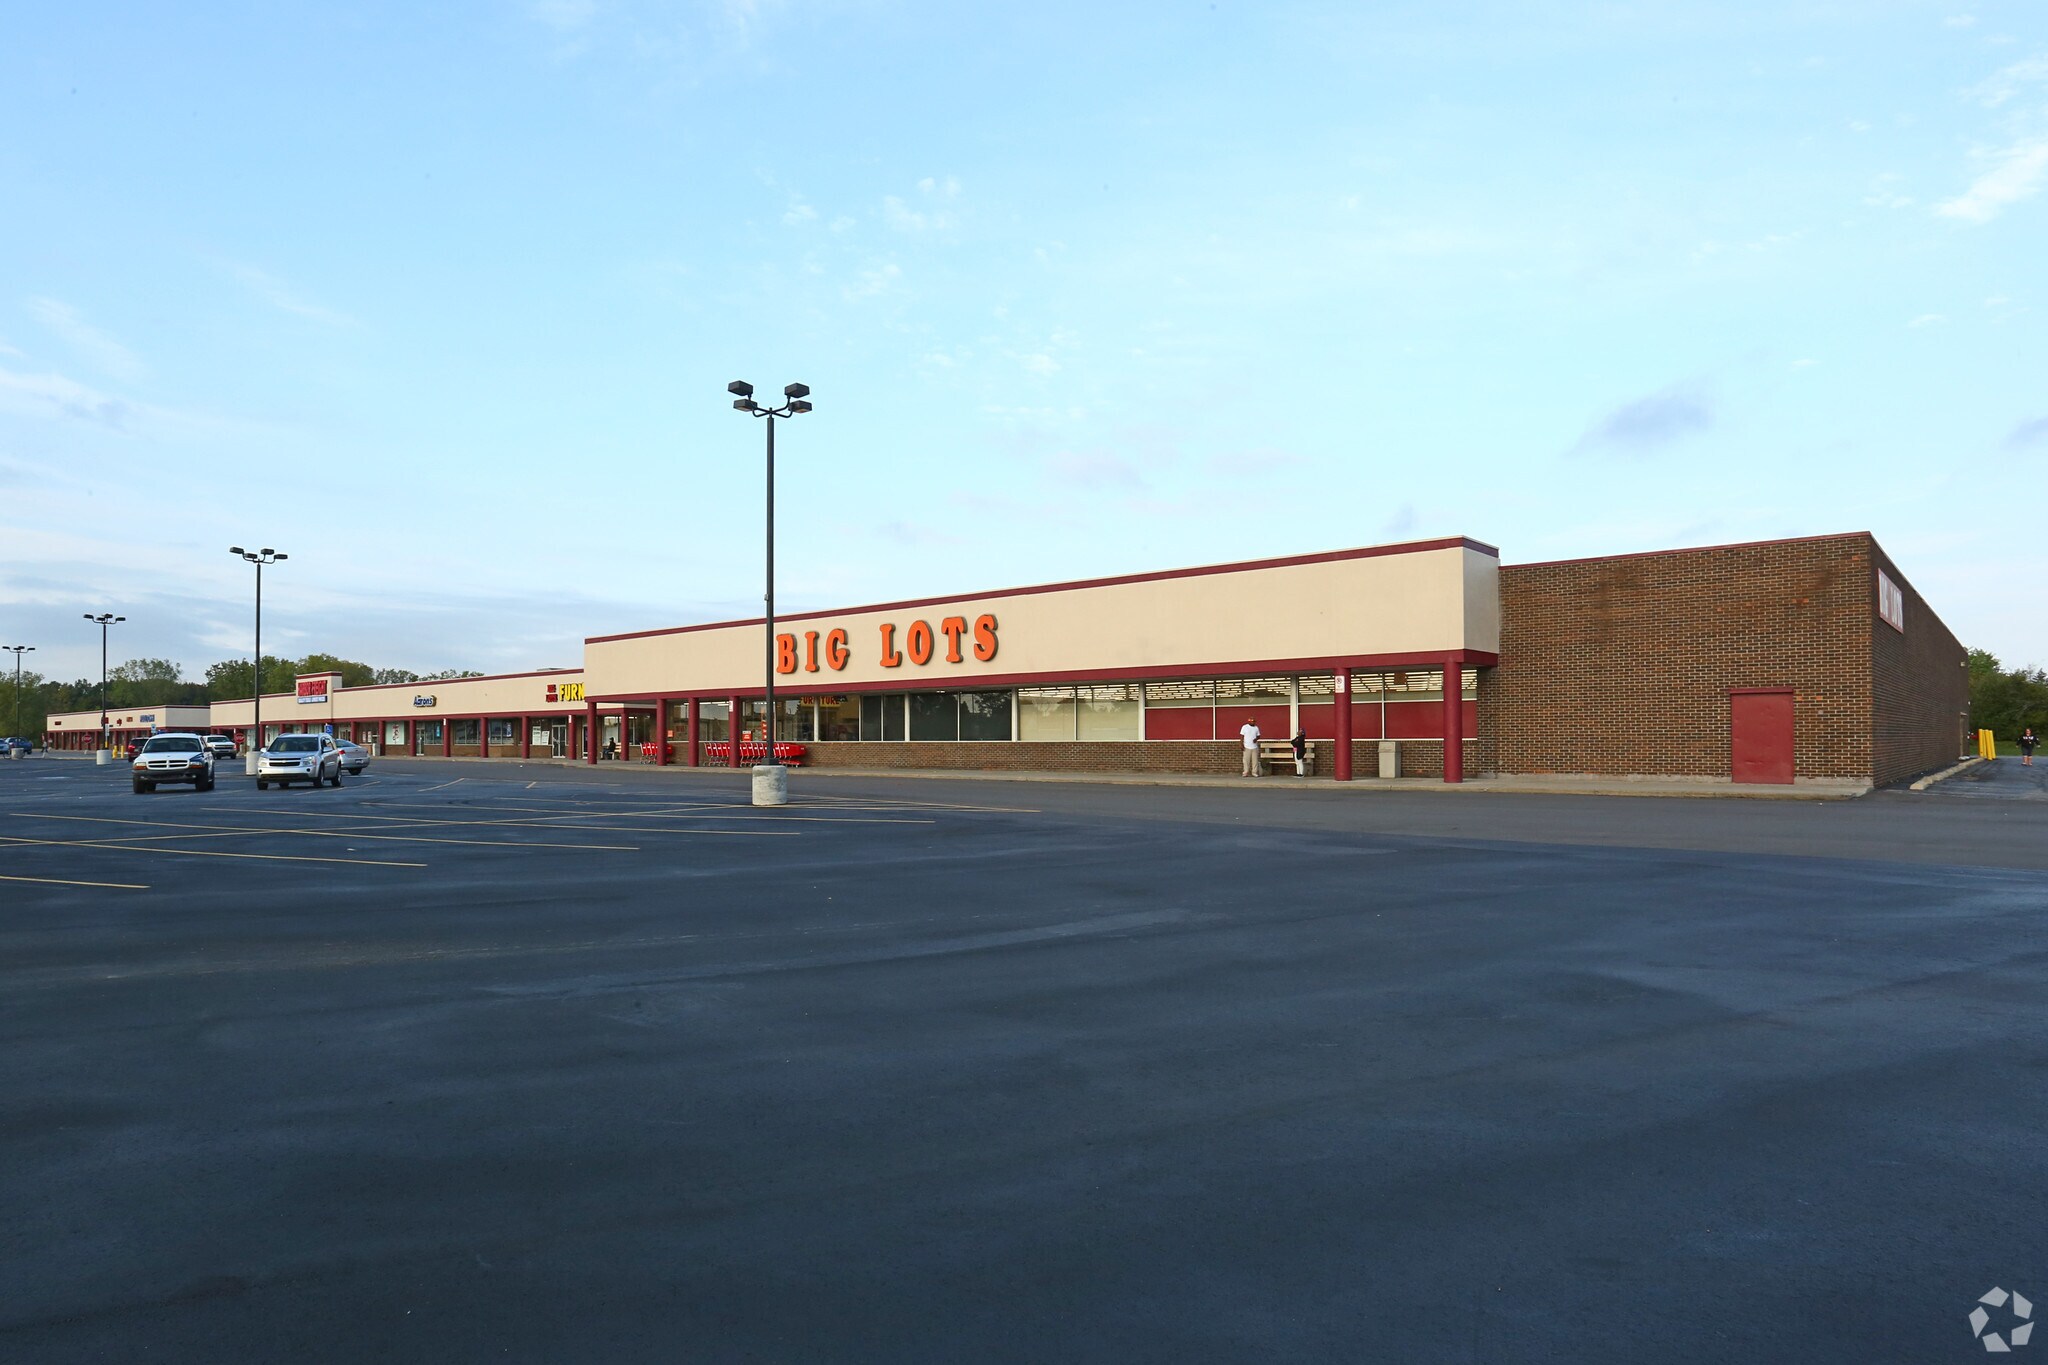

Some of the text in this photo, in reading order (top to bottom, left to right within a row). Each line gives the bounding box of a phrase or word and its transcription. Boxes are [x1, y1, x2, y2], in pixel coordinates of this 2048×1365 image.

[776, 614, 998, 674] BIG LOTS
[559, 683, 585, 702] FURN
